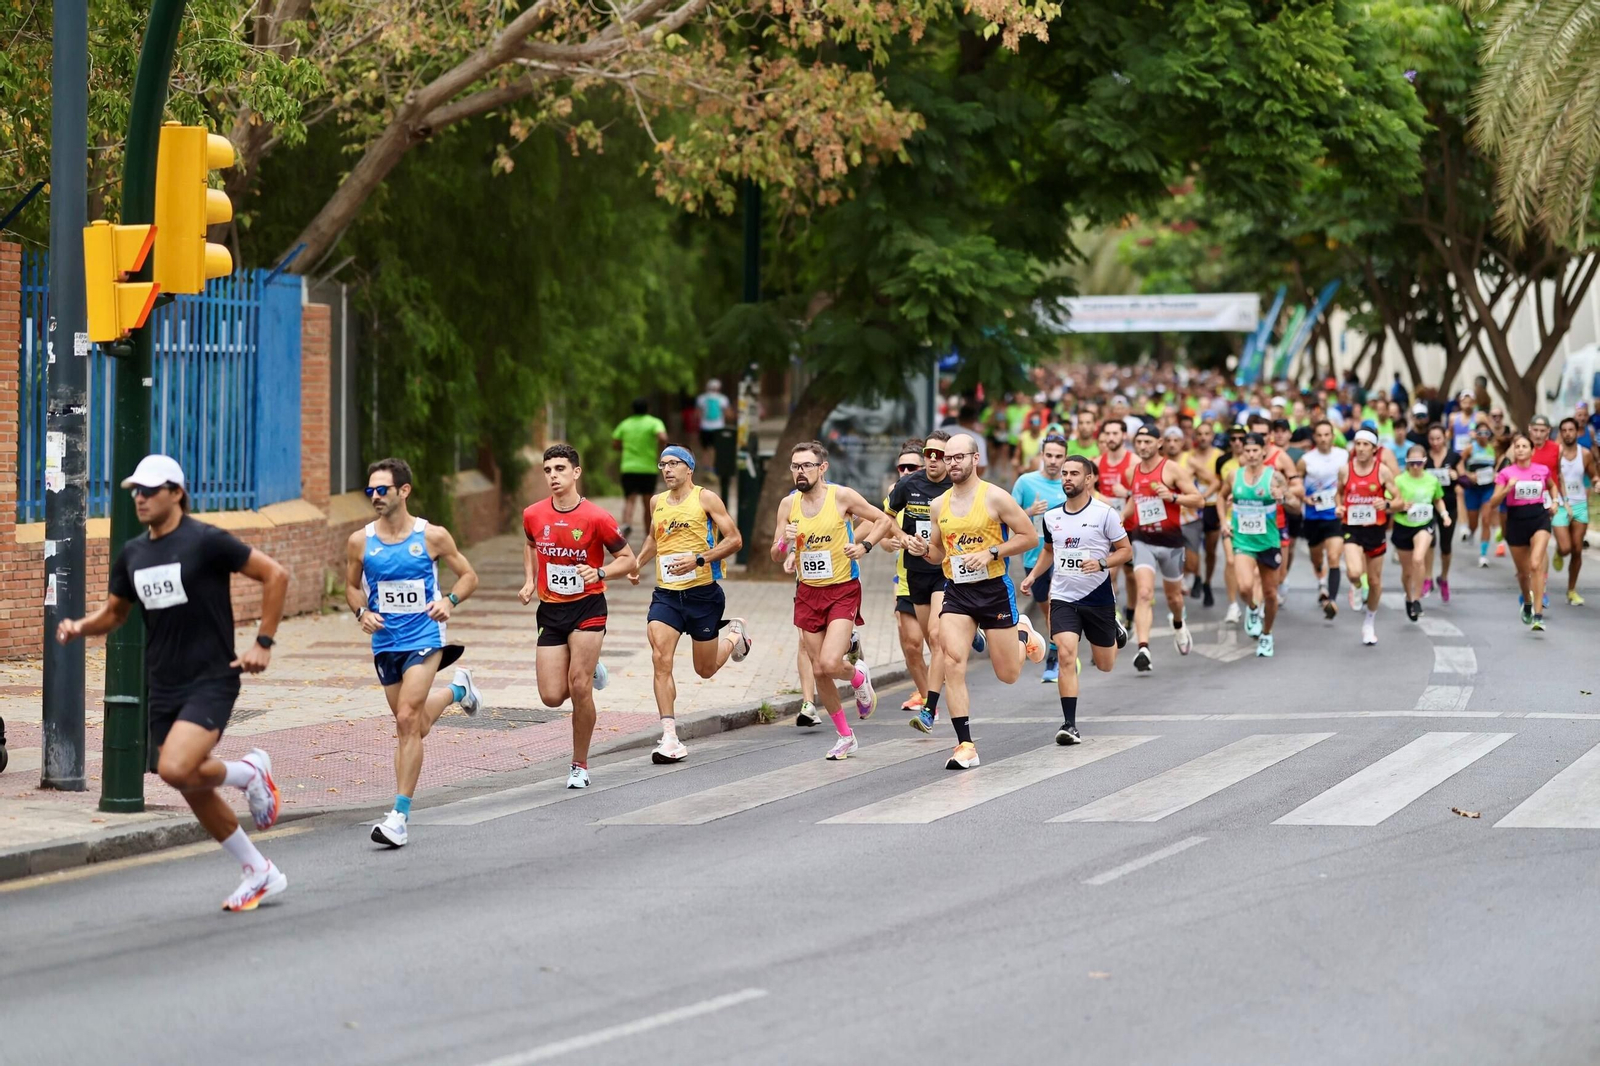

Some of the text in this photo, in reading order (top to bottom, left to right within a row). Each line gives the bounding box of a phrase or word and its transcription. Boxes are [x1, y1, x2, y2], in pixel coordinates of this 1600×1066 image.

[1141, 507, 1160, 518] 732
[1242, 521, 1261, 529] 403
[803, 560, 825, 571] 692
[551, 574, 576, 586] 241
[142, 580, 174, 598] 859
[385, 591, 418, 604] 510
